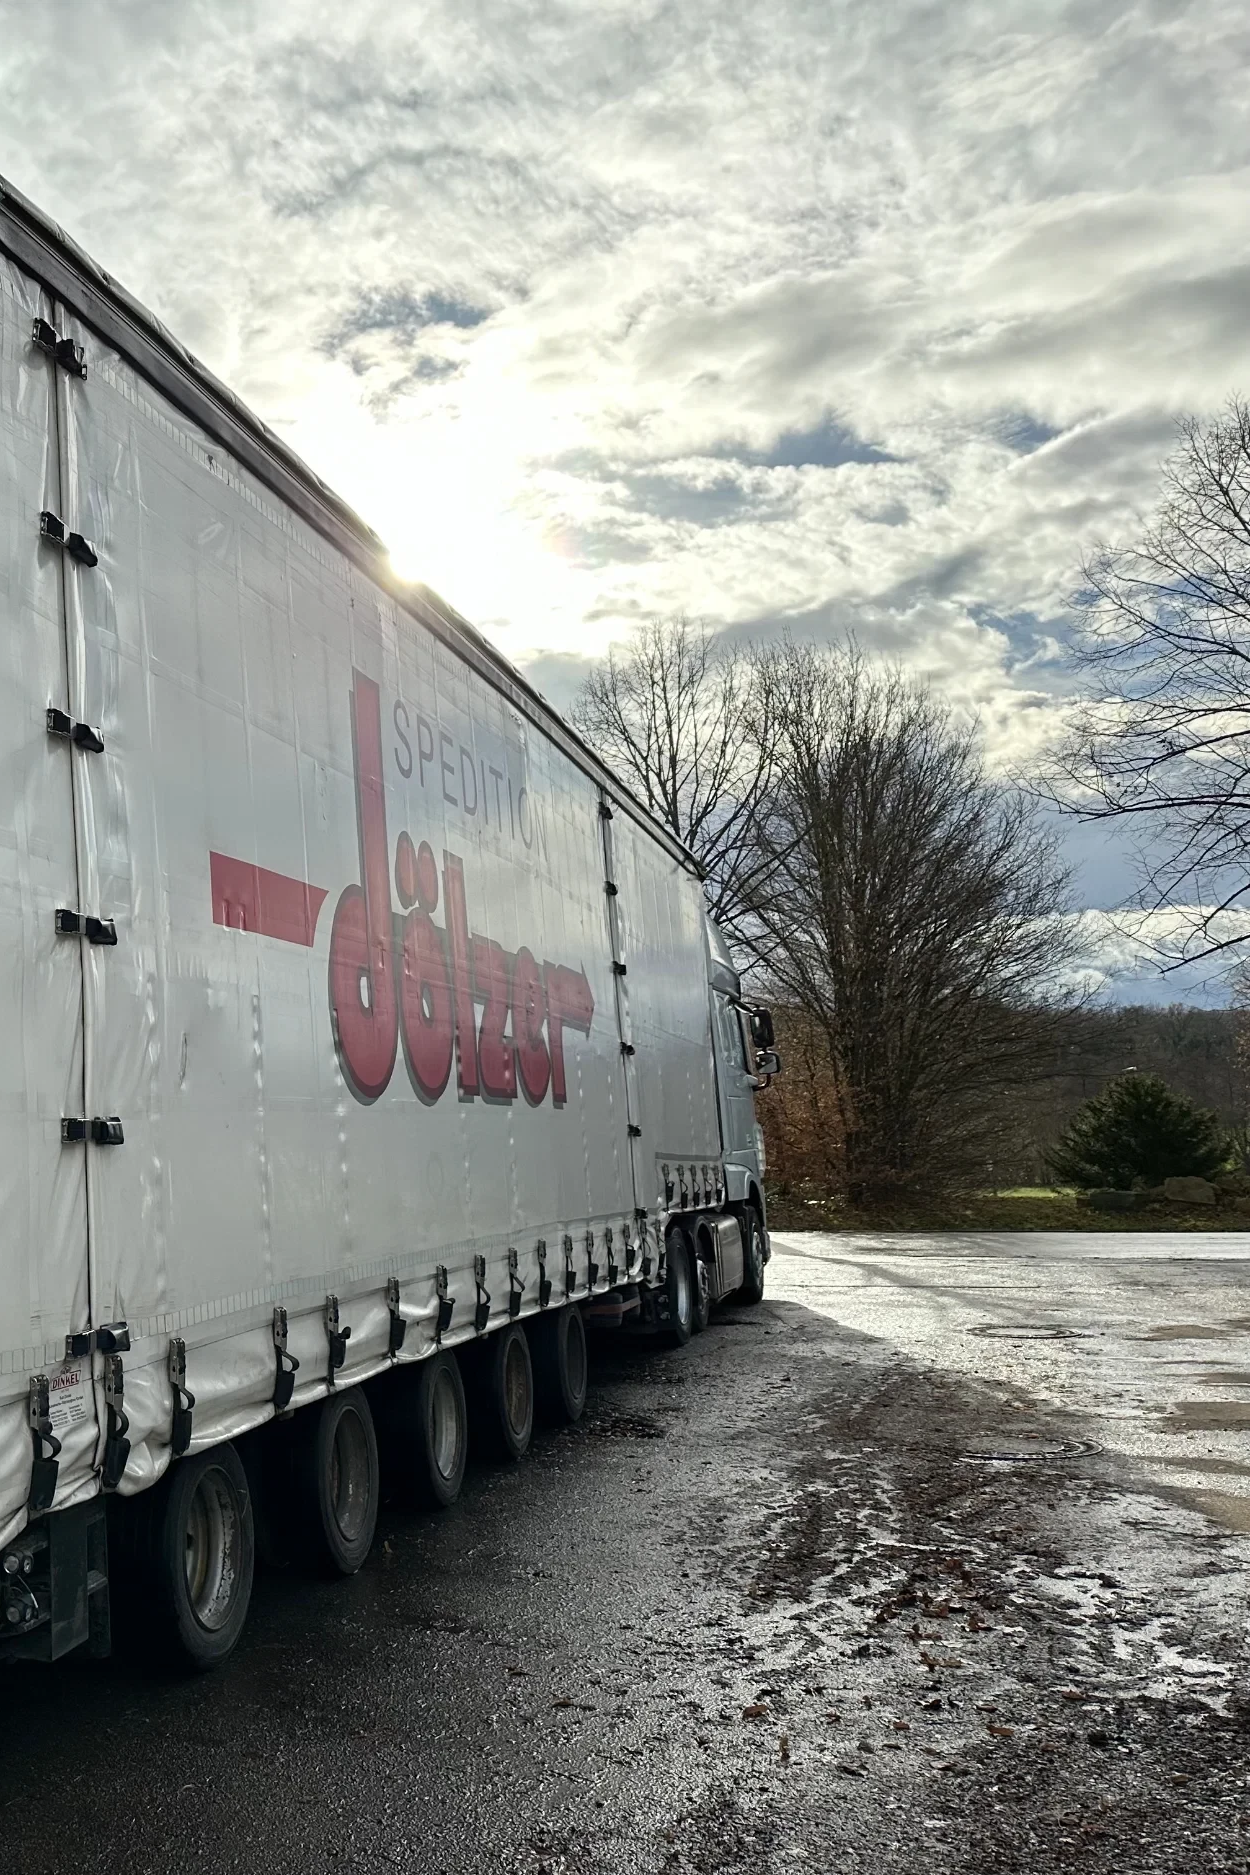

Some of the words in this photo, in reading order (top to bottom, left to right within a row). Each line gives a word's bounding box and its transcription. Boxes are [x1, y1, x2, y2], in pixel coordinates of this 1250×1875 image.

[391, 698, 549, 861] SPEDITION
[329, 666, 586, 1106] dölzer
[53, 1374, 79, 1388] DINKEL
